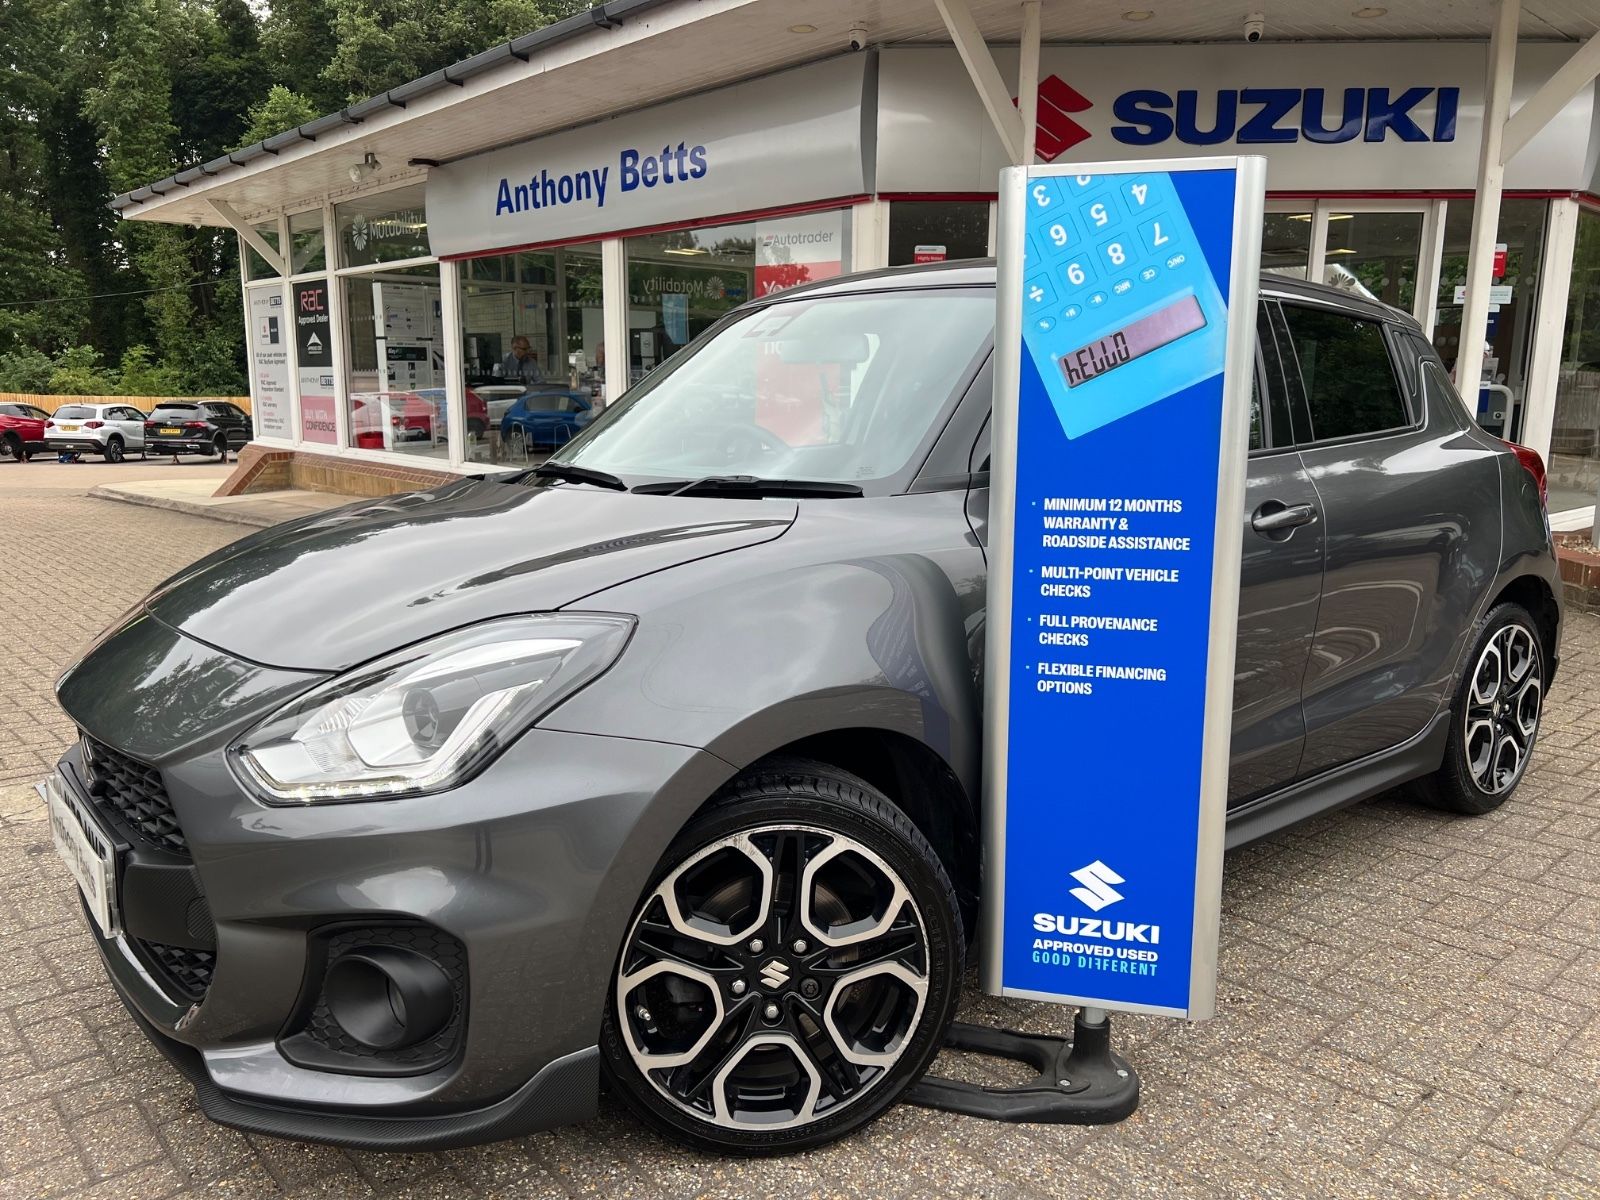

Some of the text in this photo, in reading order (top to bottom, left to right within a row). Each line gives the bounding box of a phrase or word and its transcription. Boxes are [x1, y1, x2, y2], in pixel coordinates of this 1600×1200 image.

[1110, 87, 1461, 146] SUZUKI
[495, 141, 708, 217] Anthony Betts
[1033, 185, 1050, 206] 3
[1131, 183, 1148, 205] 4
[1090, 203, 1108, 227] 5
[369, 210, 422, 240] Motability
[772, 231, 834, 247] Autotrader
[1107, 243, 1125, 265] 8
[305, 420, 336, 433] CONFIDENCE
[1044, 498, 1182, 513] MINIMUM 12 MONTHS
[1043, 516, 1129, 530] WARRANTY &
[1042, 535, 1190, 551] ROADSIDE ASSISTANCE
[1041, 566, 1179, 582] MULTI-POINT VEHICLE
[1040, 584, 1091, 598] CHECKS
[1039, 614, 1158, 632] FULL PROVENANCE
[1039, 632, 1089, 646] CHECKS
[1037, 662, 1167, 681] FLEXIBLE FINANCING
[1037, 680, 1092, 695] OPTIONS
[1033, 912, 1160, 945] SUZUKI
[1033, 938, 1158, 962] APPROVED USED
[1032, 950, 1158, 977] GOOD DIFFERENT
